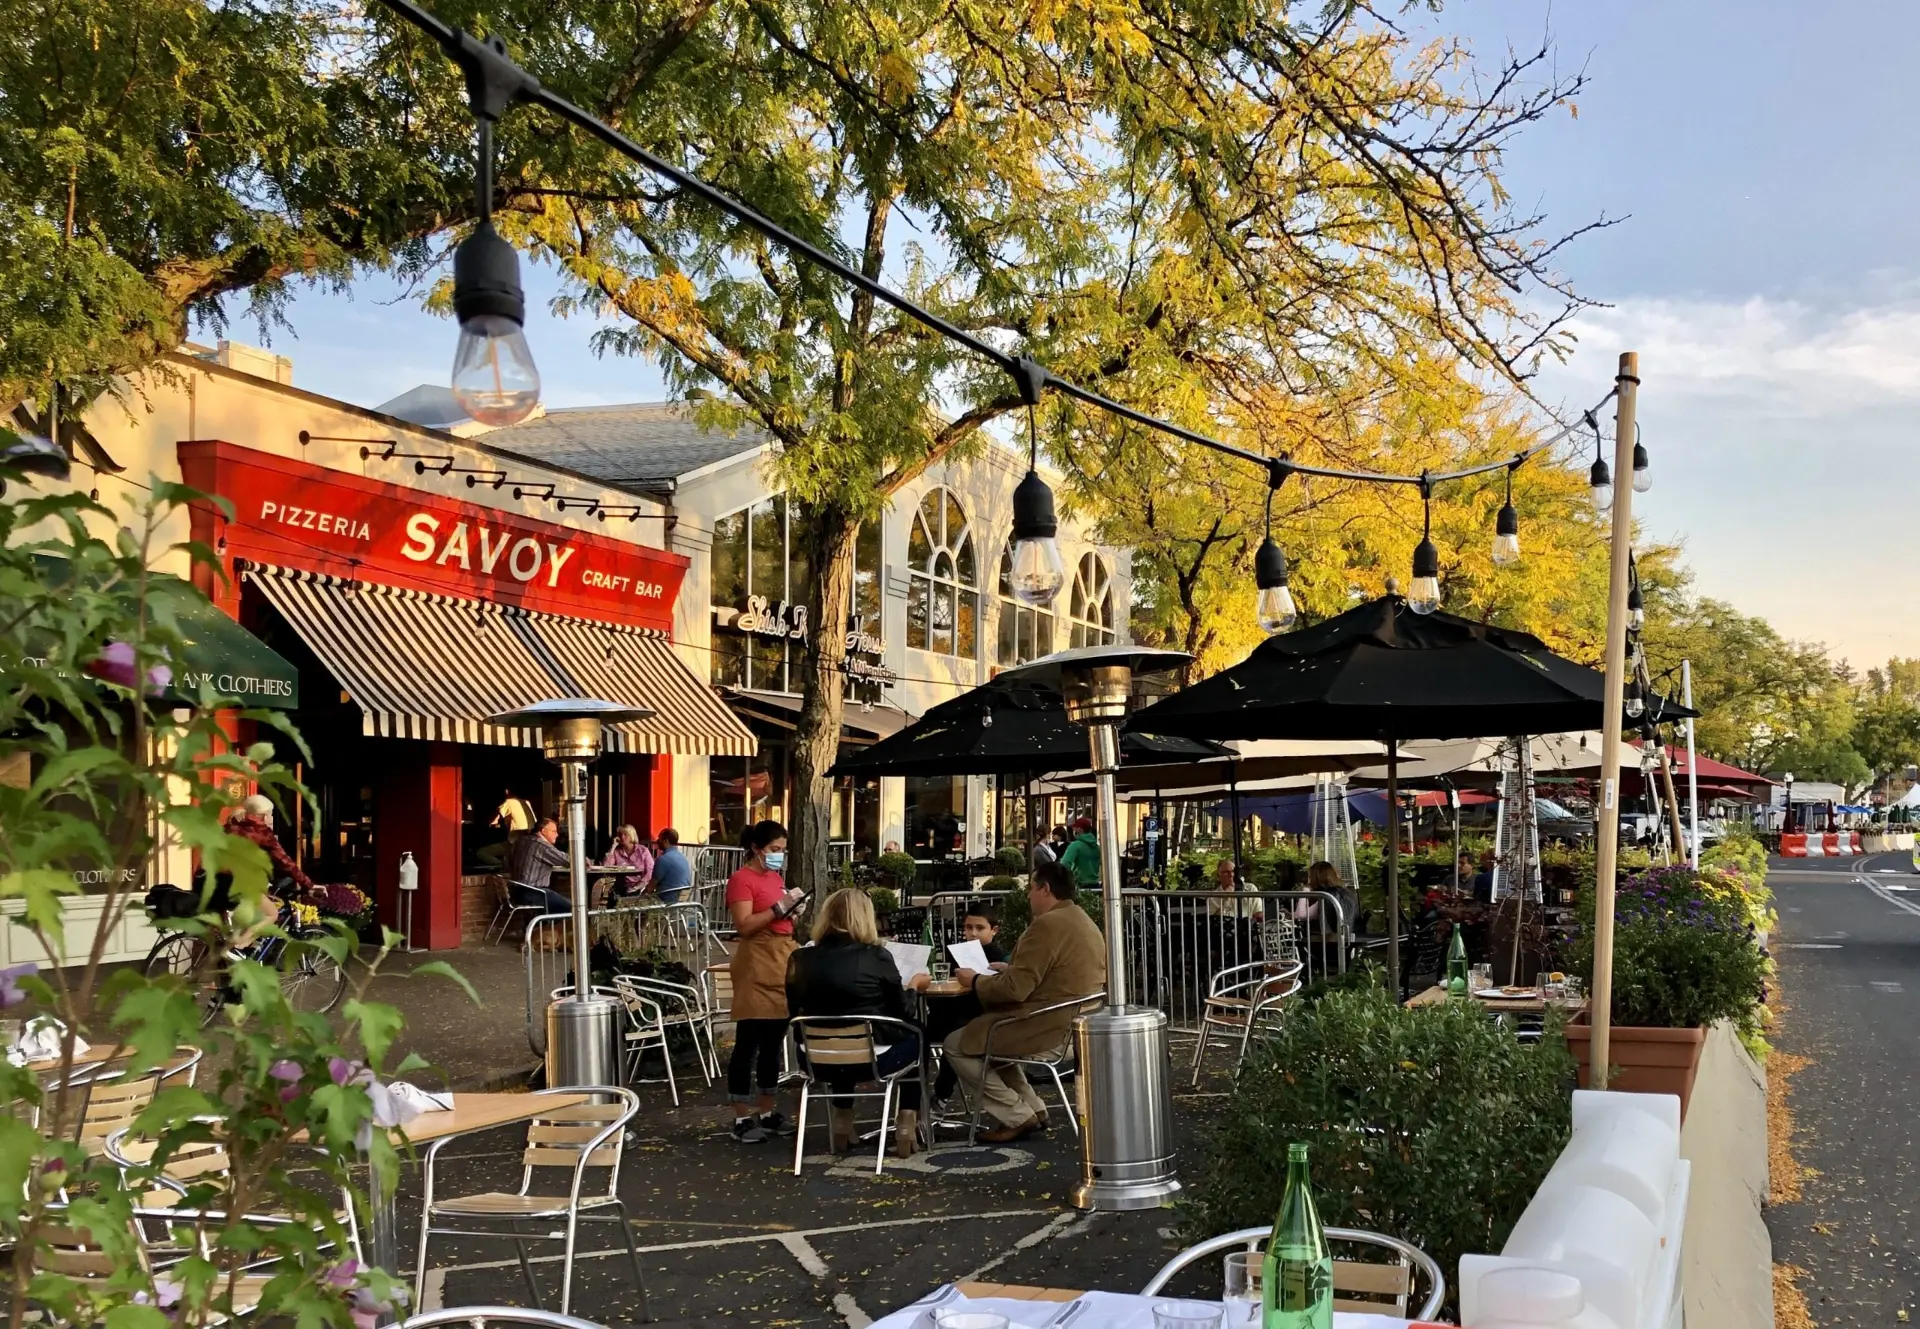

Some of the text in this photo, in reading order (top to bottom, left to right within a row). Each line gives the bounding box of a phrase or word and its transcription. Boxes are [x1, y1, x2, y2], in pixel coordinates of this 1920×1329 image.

[260, 500, 664, 600] PIZZERIA SAVOY CRAFT BAR
[737, 594, 786, 638] Shish
[218, 674, 292, 697] CLOTHIERS
